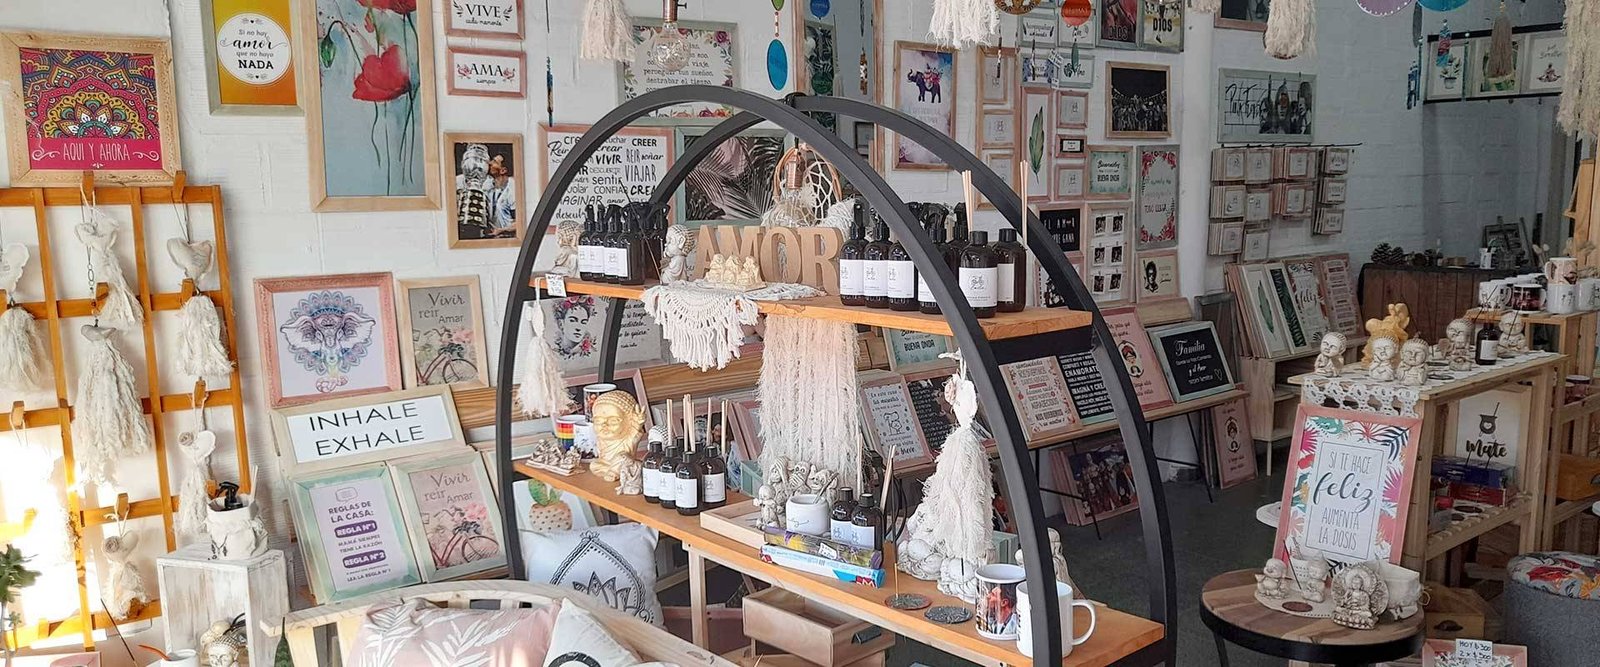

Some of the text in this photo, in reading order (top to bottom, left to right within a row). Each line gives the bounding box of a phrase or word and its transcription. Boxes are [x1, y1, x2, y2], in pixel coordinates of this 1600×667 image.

[466, 4, 501, 18] VIVE
[256, 30, 267, 38] hay
[233, 39, 273, 49] amor
[238, 59, 274, 70] NADA
[470, 63, 503, 76] AMA
[632, 139, 657, 147] CREER
[88, 143, 95, 160] Y
[100, 143, 131, 161] AHORA
[596, 154, 622, 165] VIVIR
[592, 174, 622, 185] sentir
[625, 164, 656, 182] VIAJAR
[594, 185, 628, 195] CONFIAR
[560, 195, 603, 206] AGINAR
[694, 225, 842, 296] AMOR
[428, 292, 466, 306] Vivir
[439, 314, 464, 324] Amar
[904, 339, 935, 351] BUENA ONDA
[1175, 340, 1205, 356] Familia
[309, 402, 418, 432] INHALE
[315, 425, 424, 456] EXHALE
[1466, 439, 1508, 458] Mate
[1328, 451, 1372, 474] SI TE HACE
[430, 472, 471, 488] Vivir
[447, 492, 473, 504] Amar
[1313, 472, 1375, 513] feliz
[328, 503, 360, 514] REGLAS
[331, 510, 374, 523] LA CASA:
[1322, 507, 1360, 530] AUMENTA
[337, 526, 362, 536] REGLA
[1318, 527, 1357, 551] LA DOSIS
[344, 555, 370, 566] REGLA
